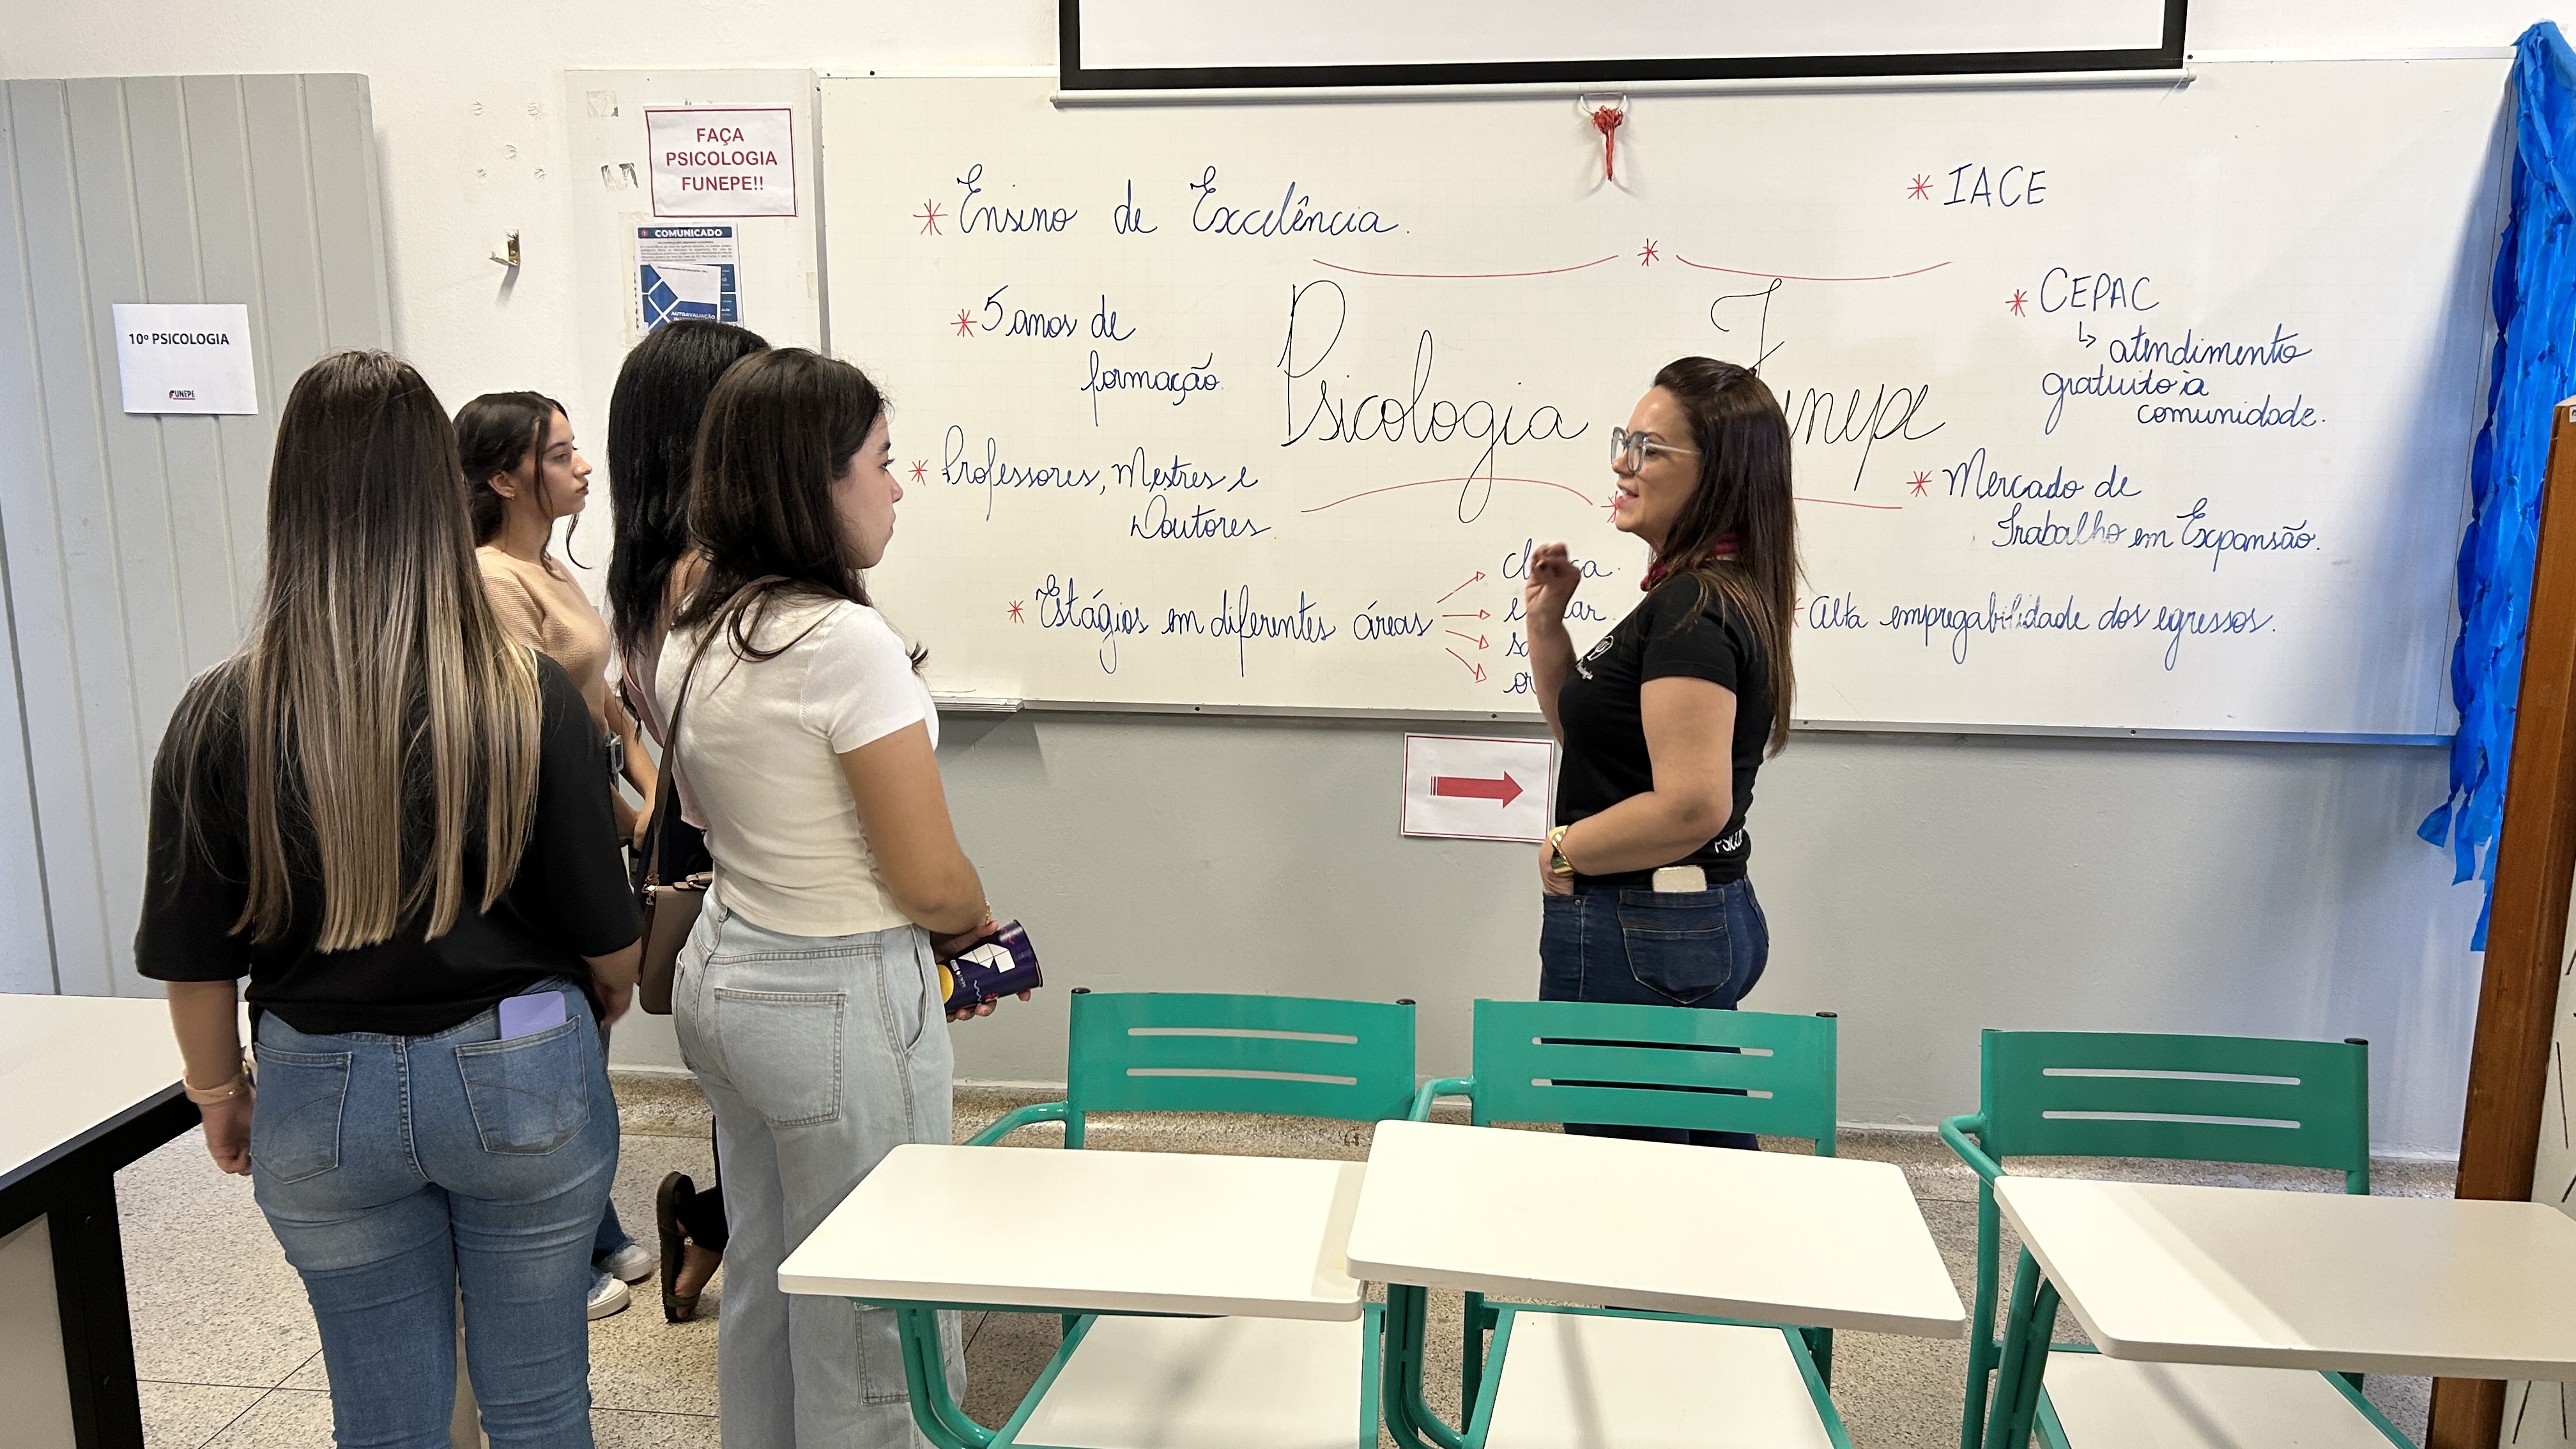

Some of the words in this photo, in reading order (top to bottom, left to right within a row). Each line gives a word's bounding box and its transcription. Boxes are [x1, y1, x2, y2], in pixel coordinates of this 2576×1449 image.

[666, 151, 778, 167] PSICOLOGIA
[696, 128, 744, 146] FAÇA
[681, 176, 763, 191] FUNEPE!!
[956, 164, 1078, 234] Ensino
[1114, 179, 1158, 234] de
[1190, 165, 1410, 237] Excelência.
[1943, 163, 2046, 207] IACE
[655, 229, 723, 237] COMUNICADO
[981, 285, 1009, 332] 5
[1006, 307, 1078, 339] anos
[1091, 295, 1136, 341] de
[2040, 267, 2160, 313] CEPAC
[671, 310, 716, 320] AUTOAVALIAÇÃO
[152, 333, 230, 345] PSICOLOGIA
[2110, 323, 2313, 366] atendimento
[1277, 280, 1588, 523] Psicologia
[2042, 364, 2178, 435] gratuito
[2137, 394, 2326, 427] comunidade.
[942, 425, 1105, 521] Professores,
[1111, 446, 1226, 493] Mestres
[1227, 466, 1258, 493] e
[1942, 447, 2085, 500] Mercado
[2094, 465, 2142, 497] de
[1991, 503, 2126, 548] Trabalho
[2128, 527, 2175, 550] em
[2176, 498, 2322, 572] Expansão.
[1035, 574, 1149, 674] Estágios
[1161, 608, 1204, 634] em
[1211, 584, 1336, 678] diferentes
[1353, 600, 1433, 640] áreas
[1809, 595, 1868, 631] Alta
[1880, 592, 2090, 664] empregabilidade
[2099, 597, 2150, 631] dos
[2152, 610, 2276, 670] egressos.
